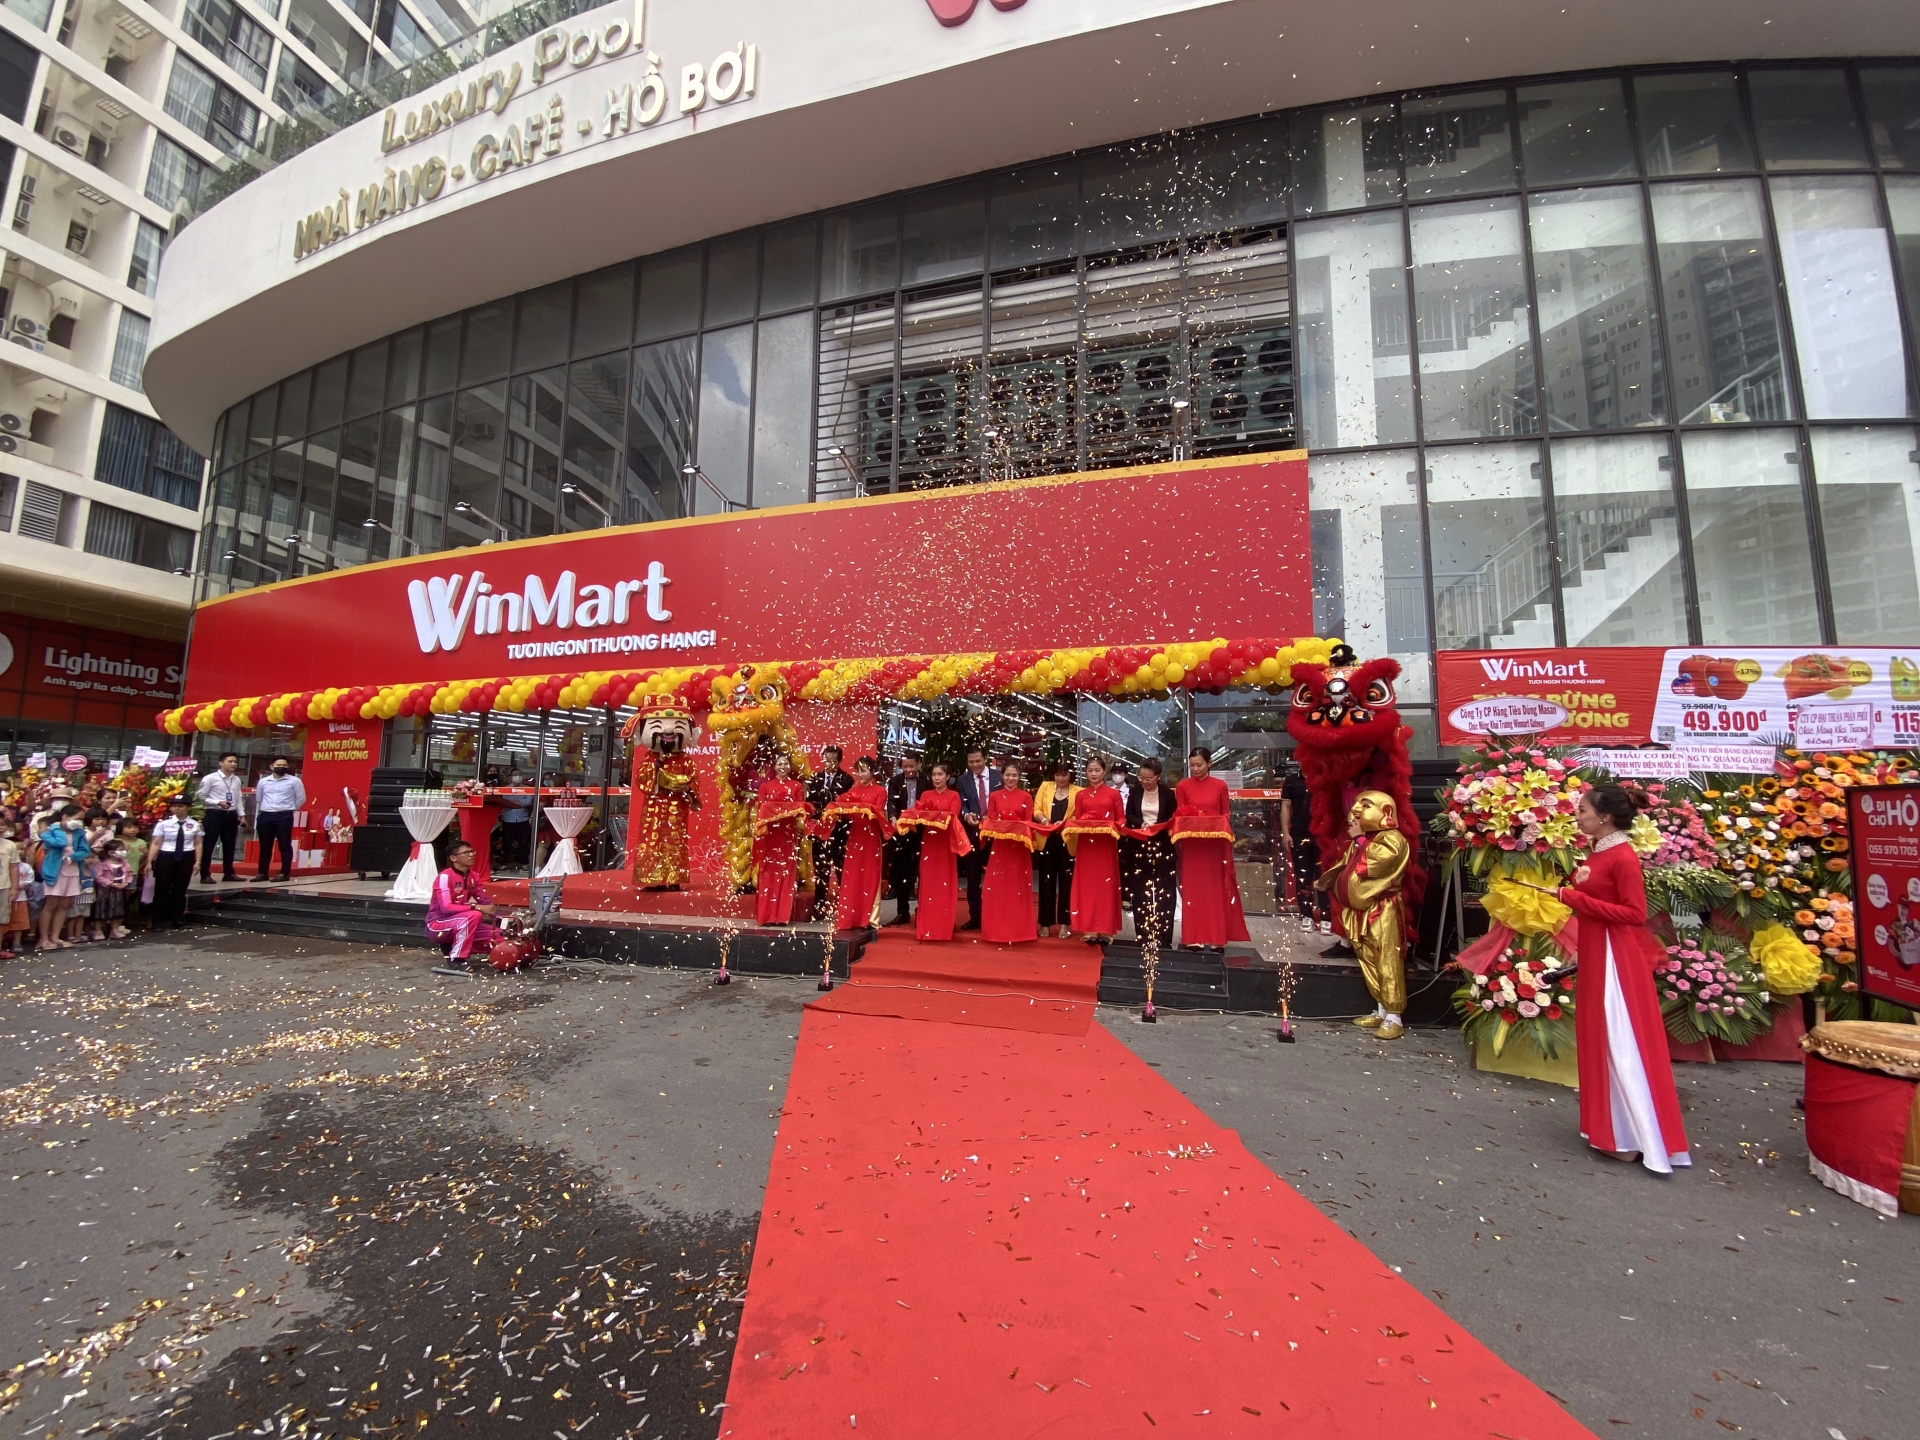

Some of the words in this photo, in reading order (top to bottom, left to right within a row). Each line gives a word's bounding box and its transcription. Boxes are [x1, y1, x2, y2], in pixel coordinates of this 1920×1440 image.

[381, 61, 521, 154] Luxury
[532, 0, 646, 84] Pool
[294, 187, 349, 258] NHÀ
[355, 156, 446, 229] HÀNG
[602, 50, 667, 139] HỒ
[680, 41, 758, 115] BƠI
[408, 561, 672, 653] WinMart
[543, 639, 590, 657] NGON
[44, 647, 159, 685] Lightning
[165, 666, 187, 685] S
[1480, 658, 1588, 681] WinMart
[43, 675, 67, 686] Anh
[1561, 709, 1629, 729] ƯƠNG
[313, 751, 333, 761] KHAI
[1886, 793, 1919, 832] HỘ
[1869, 844, 1883, 854] 055
[1884, 845, 1898, 855] 970
[1899, 845, 1918, 856] 1705
